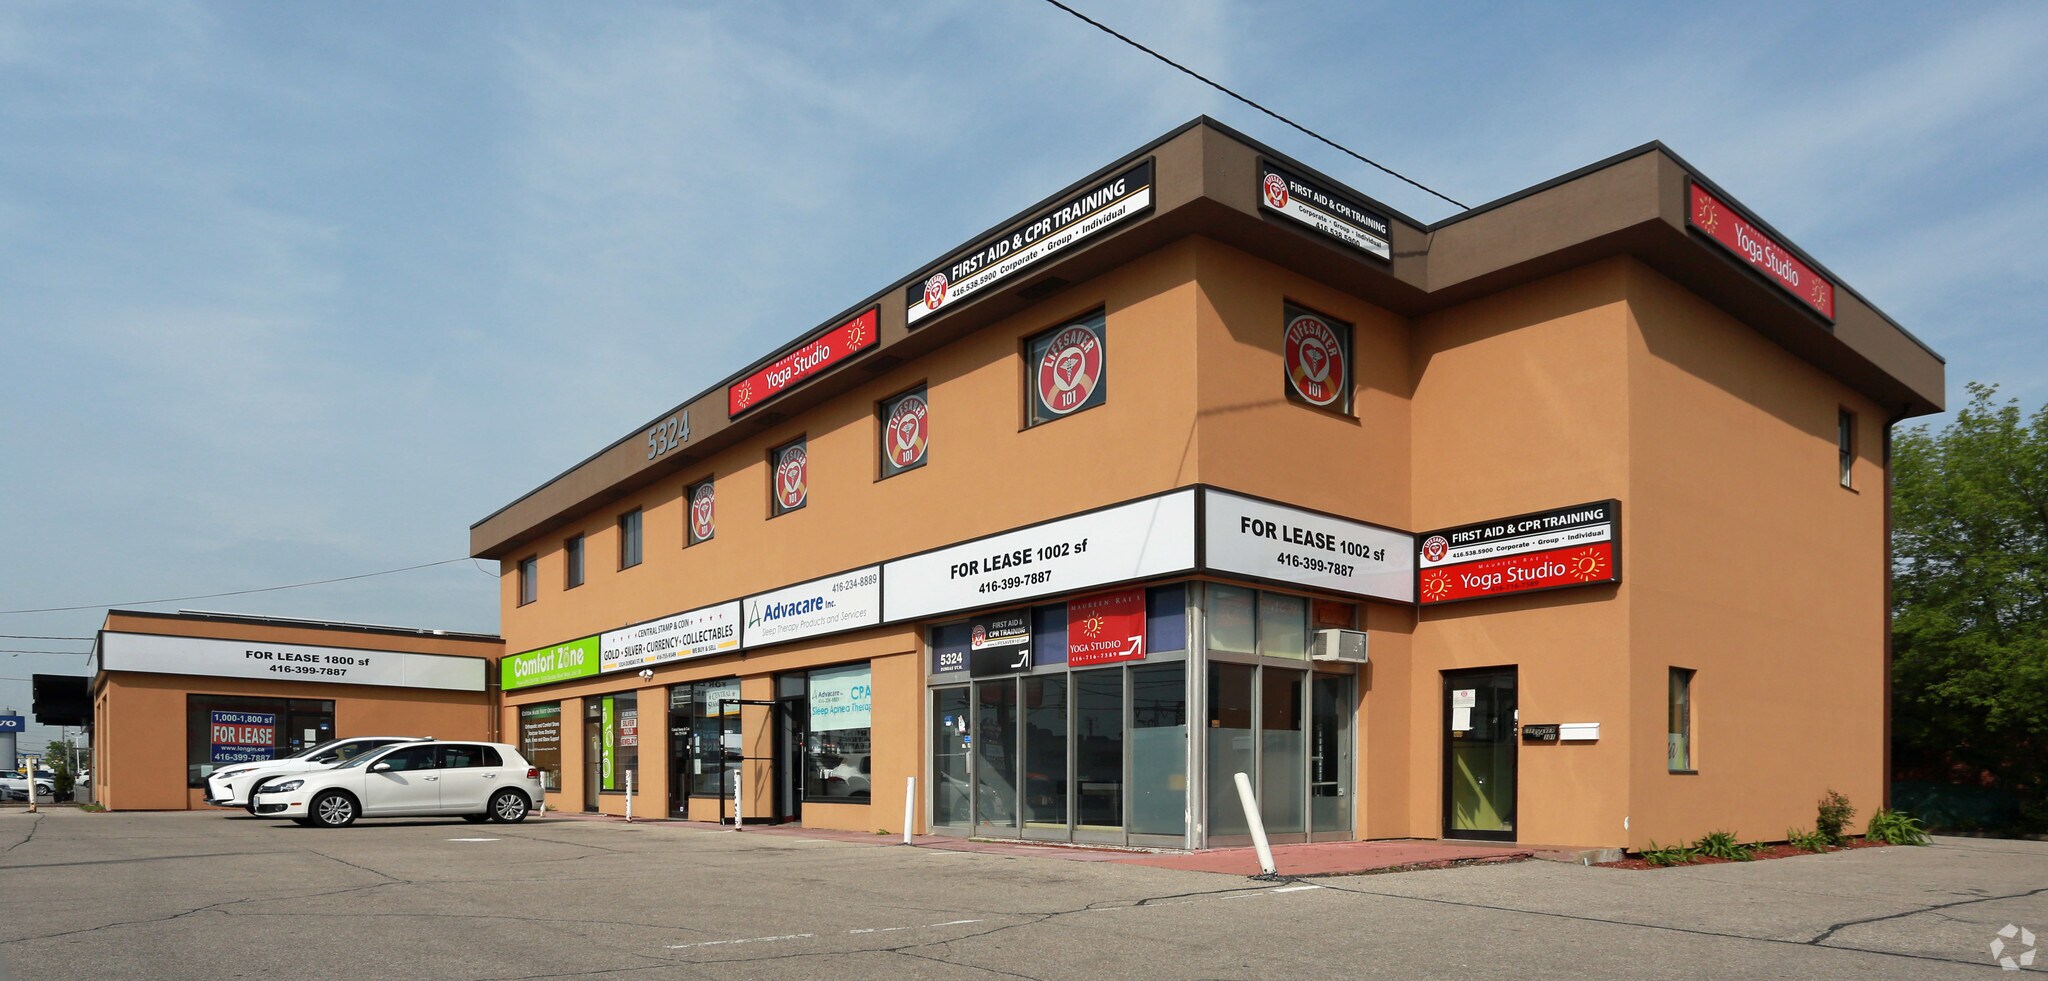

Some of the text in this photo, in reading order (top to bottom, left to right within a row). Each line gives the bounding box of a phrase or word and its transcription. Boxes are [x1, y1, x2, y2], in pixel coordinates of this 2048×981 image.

[1290, 180, 1386, 234] FIRST AID & CPR TRAINING
[952, 178, 1126, 281] FIRST AID & CPR TRAINING
[1298, 205, 1382, 248] Corporate Group Individual
[952, 205, 1126, 297] 416.538.5900 Corporate Group Individual
[1735, 223, 1763, 262] Yoga
[1765, 247, 1798, 286] Studio
[1044, 330, 1094, 368] LIFESAVER
[1290, 320, 1337, 357] LIFESAVER
[766, 366, 791, 390] Yoga
[794, 345, 830, 376] Studio
[1062, 390, 1077, 407] 101
[1308, 381, 1322, 398] 101
[891, 400, 925, 430] LIFESAVER
[648, 410, 690, 460] 5324
[779, 449, 806, 475] LIFESAVER
[903, 450, 913, 462] 101
[1452, 508, 1604, 543] FIRST AID & CPR TRAINING
[1241, 516, 1386, 562] FOR LEASE 1002 sf
[1452, 529, 1604, 558] 416.538.5900 Corporate Group Individual
[951, 538, 1088, 580] FOR LEASE 1002 sf
[1277, 552, 1354, 577] 416-399-7887
[1478, 560, 1518, 569] MAUREEN
[832, 574, 877, 593] 416-234-8889
[979, 570, 1052, 594] 416-399-7887
[1460, 561, 1566, 590] Yoga Studio
[764, 596, 836, 622] Advacare Inc.
[1072, 600, 1109, 611] MAUREEN
[638, 619, 690, 638] CENTRAL STAMP & COIN
[762, 608, 867, 637] Sleep Therapy Products and Services
[988, 630, 1000, 638] CPR
[1000, 626, 1026, 637] TRAINING
[992, 620, 1007, 629] FIRST
[1008, 620, 1018, 628] AID
[604, 624, 733, 661] GOLD SILVER CURRENCY COLLECTABLES
[1070, 640, 1121, 654] YOGA STUDIO
[245, 650, 370, 666] FOR LEASE 1800 sf
[269, 664, 347, 676] 416-399-7887
[514, 650, 554, 677] Comfort
[557, 646, 584, 669] Zone
[940, 652, 963, 666] 5324
[818, 690, 840, 698] Advacare
[214, 714, 272, 724] 1,000-1,800 sf
[812, 707, 828, 716] Sleep
[830, 705, 850, 715] Apnea
[213, 725, 272, 745] FOR LEASE
[214, 753, 271, 761] 416-399-7887
